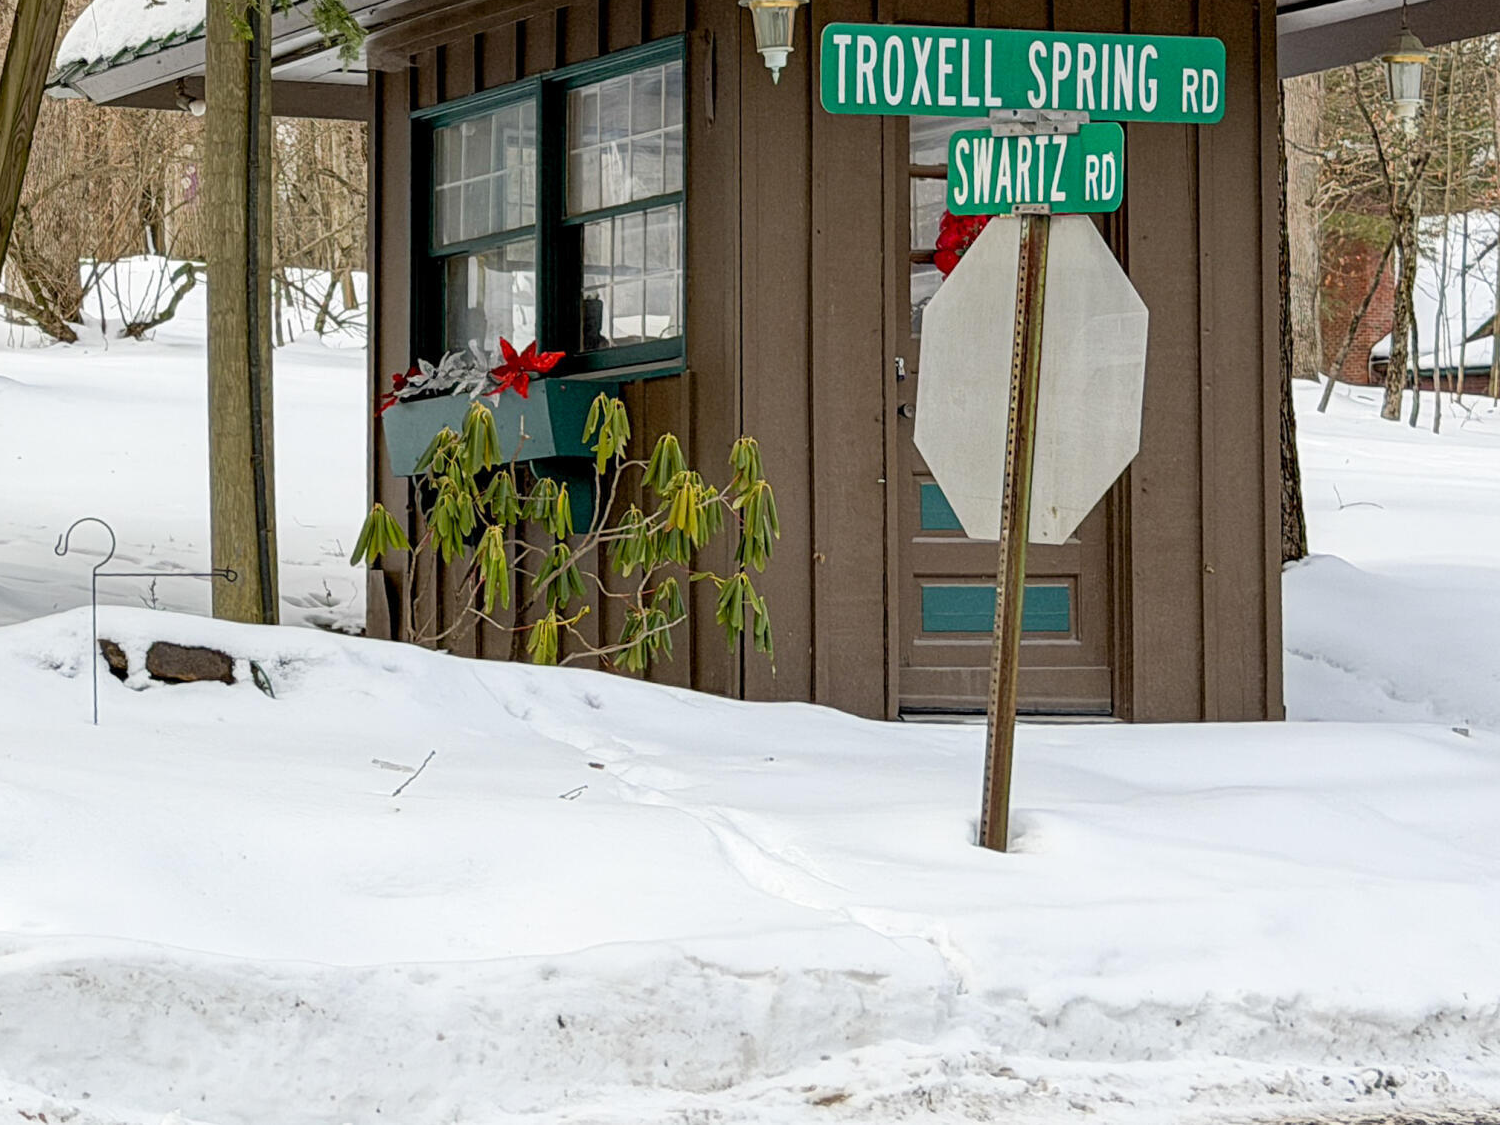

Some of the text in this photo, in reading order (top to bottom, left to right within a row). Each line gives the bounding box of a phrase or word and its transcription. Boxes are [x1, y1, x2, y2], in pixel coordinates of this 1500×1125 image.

[833, 34, 1219, 114] TROXELL SPRING RD
[953, 135, 1115, 205] SWARTZ RD
